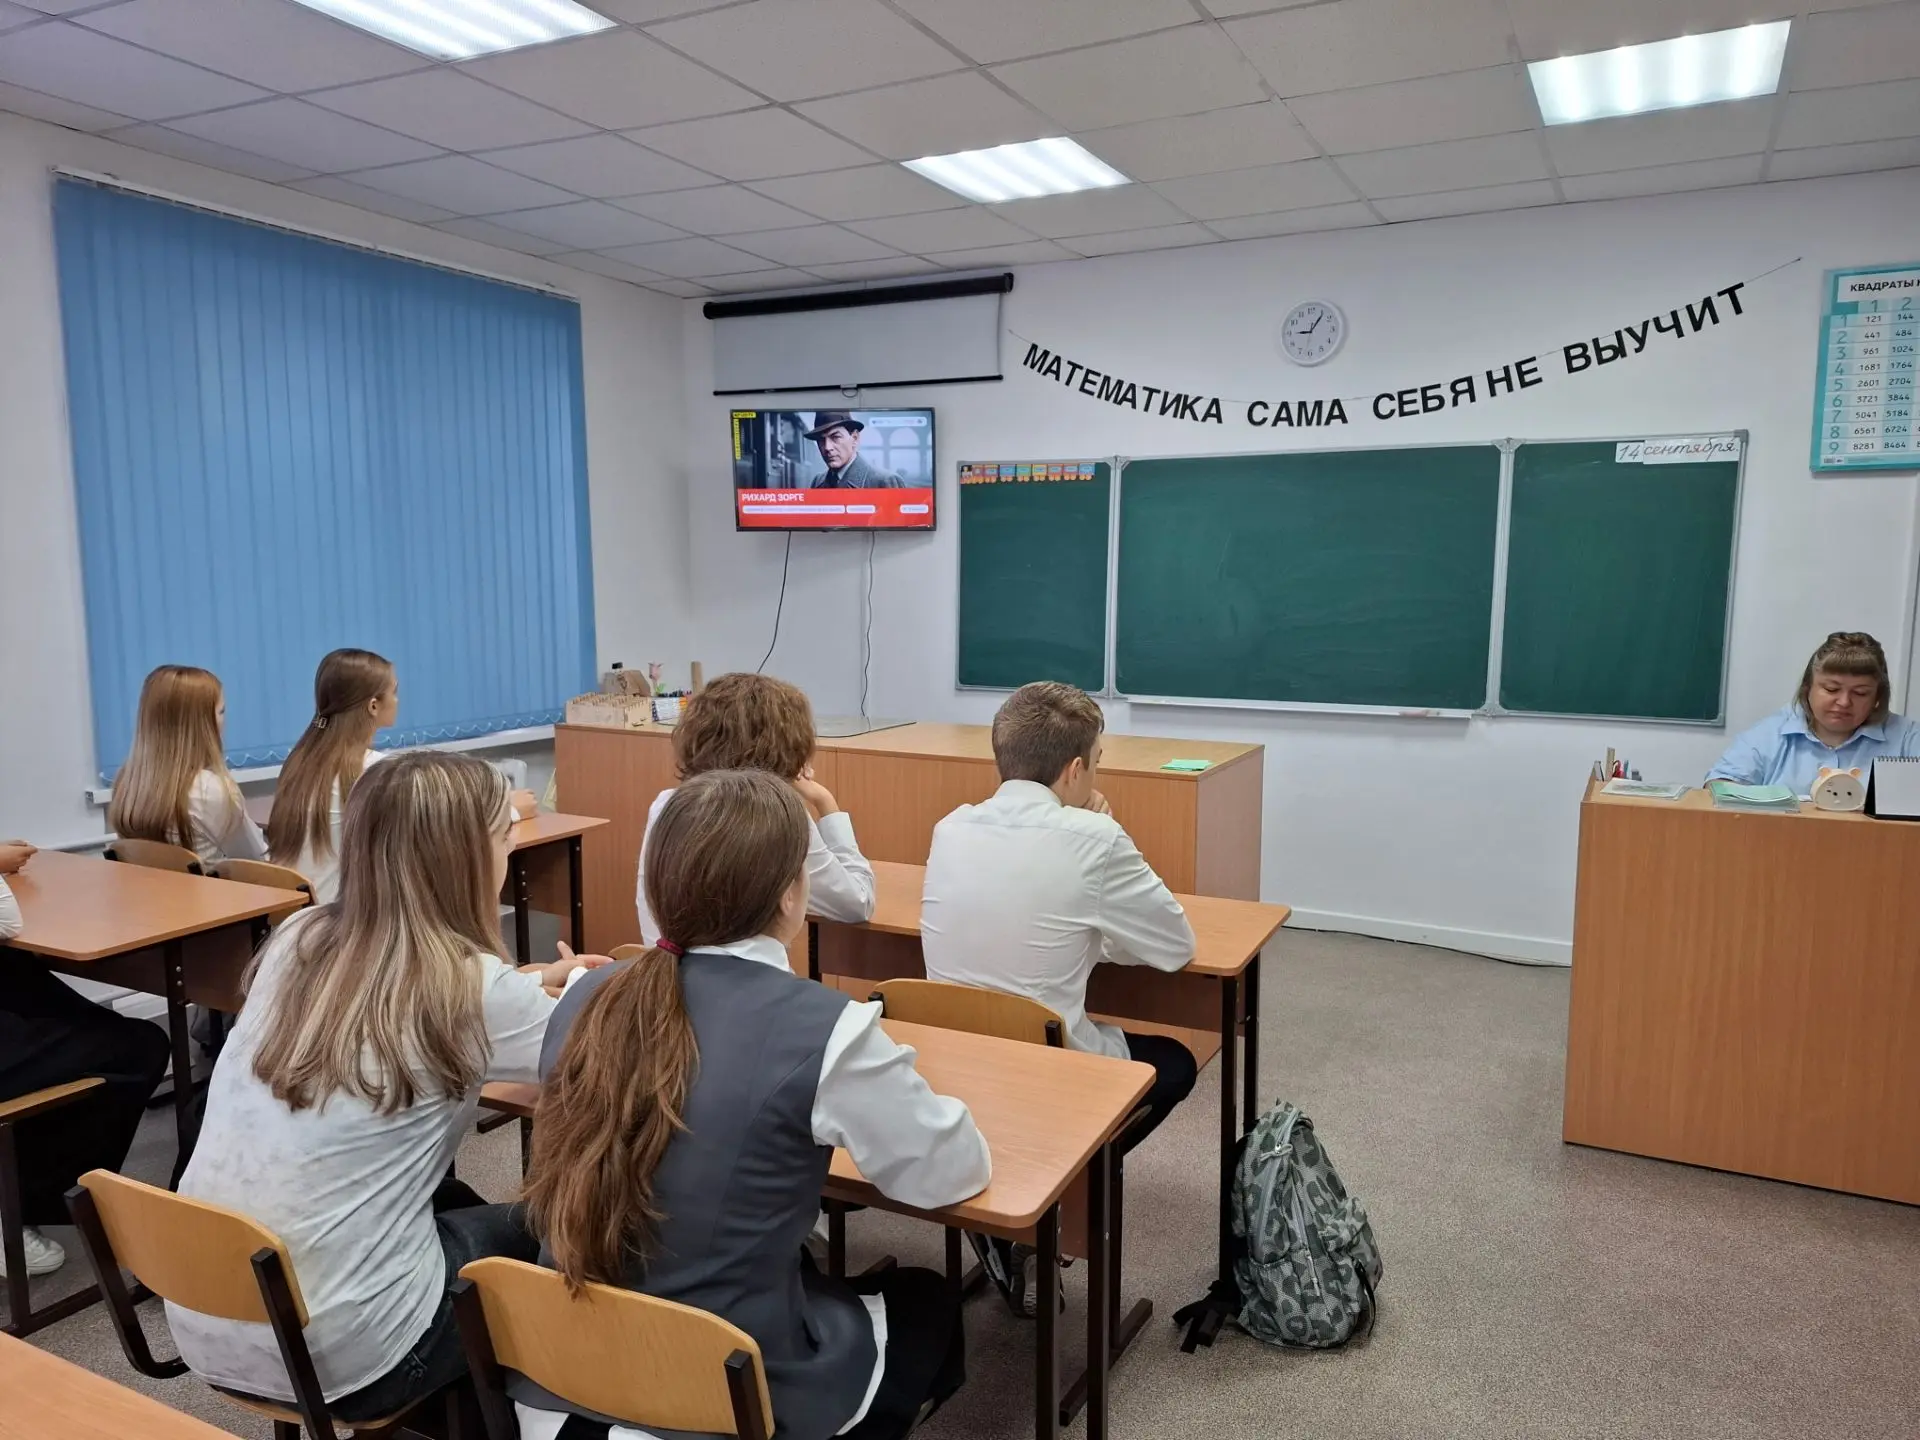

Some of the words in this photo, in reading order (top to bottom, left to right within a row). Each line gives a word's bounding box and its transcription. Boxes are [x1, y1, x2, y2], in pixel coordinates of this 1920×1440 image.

[1850, 279, 1914, 292] КВАДРАТЫ
[1871, 300, 1879, 312] 1
[1902, 297, 1912, 311] 2
[1840, 314, 1847, 327] 1
[1837, 331, 1847, 344] 2
[1896, 329, 1912, 337] 484
[1022, 343, 1223, 424] МАТЕМАТИКА
[1247, 398, 1348, 427] САМА
[1372, 375, 1477, 420] СЕБЯ
[1485, 356, 1543, 398] НЕ
[1563, 282, 1744, 374] ВЫУЧИТ
[1837, 346, 1846, 359] 3
[1835, 363, 1844, 375] 4
[1860, 363, 1880, 371] 1681
[1891, 361, 1912, 369] 1764
[1834, 378, 1843, 391] 5
[1857, 380, 1879, 388] 2601
[1889, 378, 1911, 386] 2704
[1832, 394, 1842, 408] 6
[1888, 394, 1910, 402] 3844
[1832, 410, 1841, 423] 7
[1855, 411, 1877, 419] 5041
[1886, 410, 1908, 418] 5184
[1830, 425, 1840, 439] 8
[1854, 427, 1876, 435] 6561
[1885, 425, 1907, 434] 6724
[1619, 443, 1641, 461] 14
[1829, 441, 1839, 455] 9
[1853, 442, 1874, 451] 8281
[1884, 440, 1906, 449] 8464
[742, 493, 776, 502] РИХАРД
[777, 493, 804, 501] ЗОРГЕ
